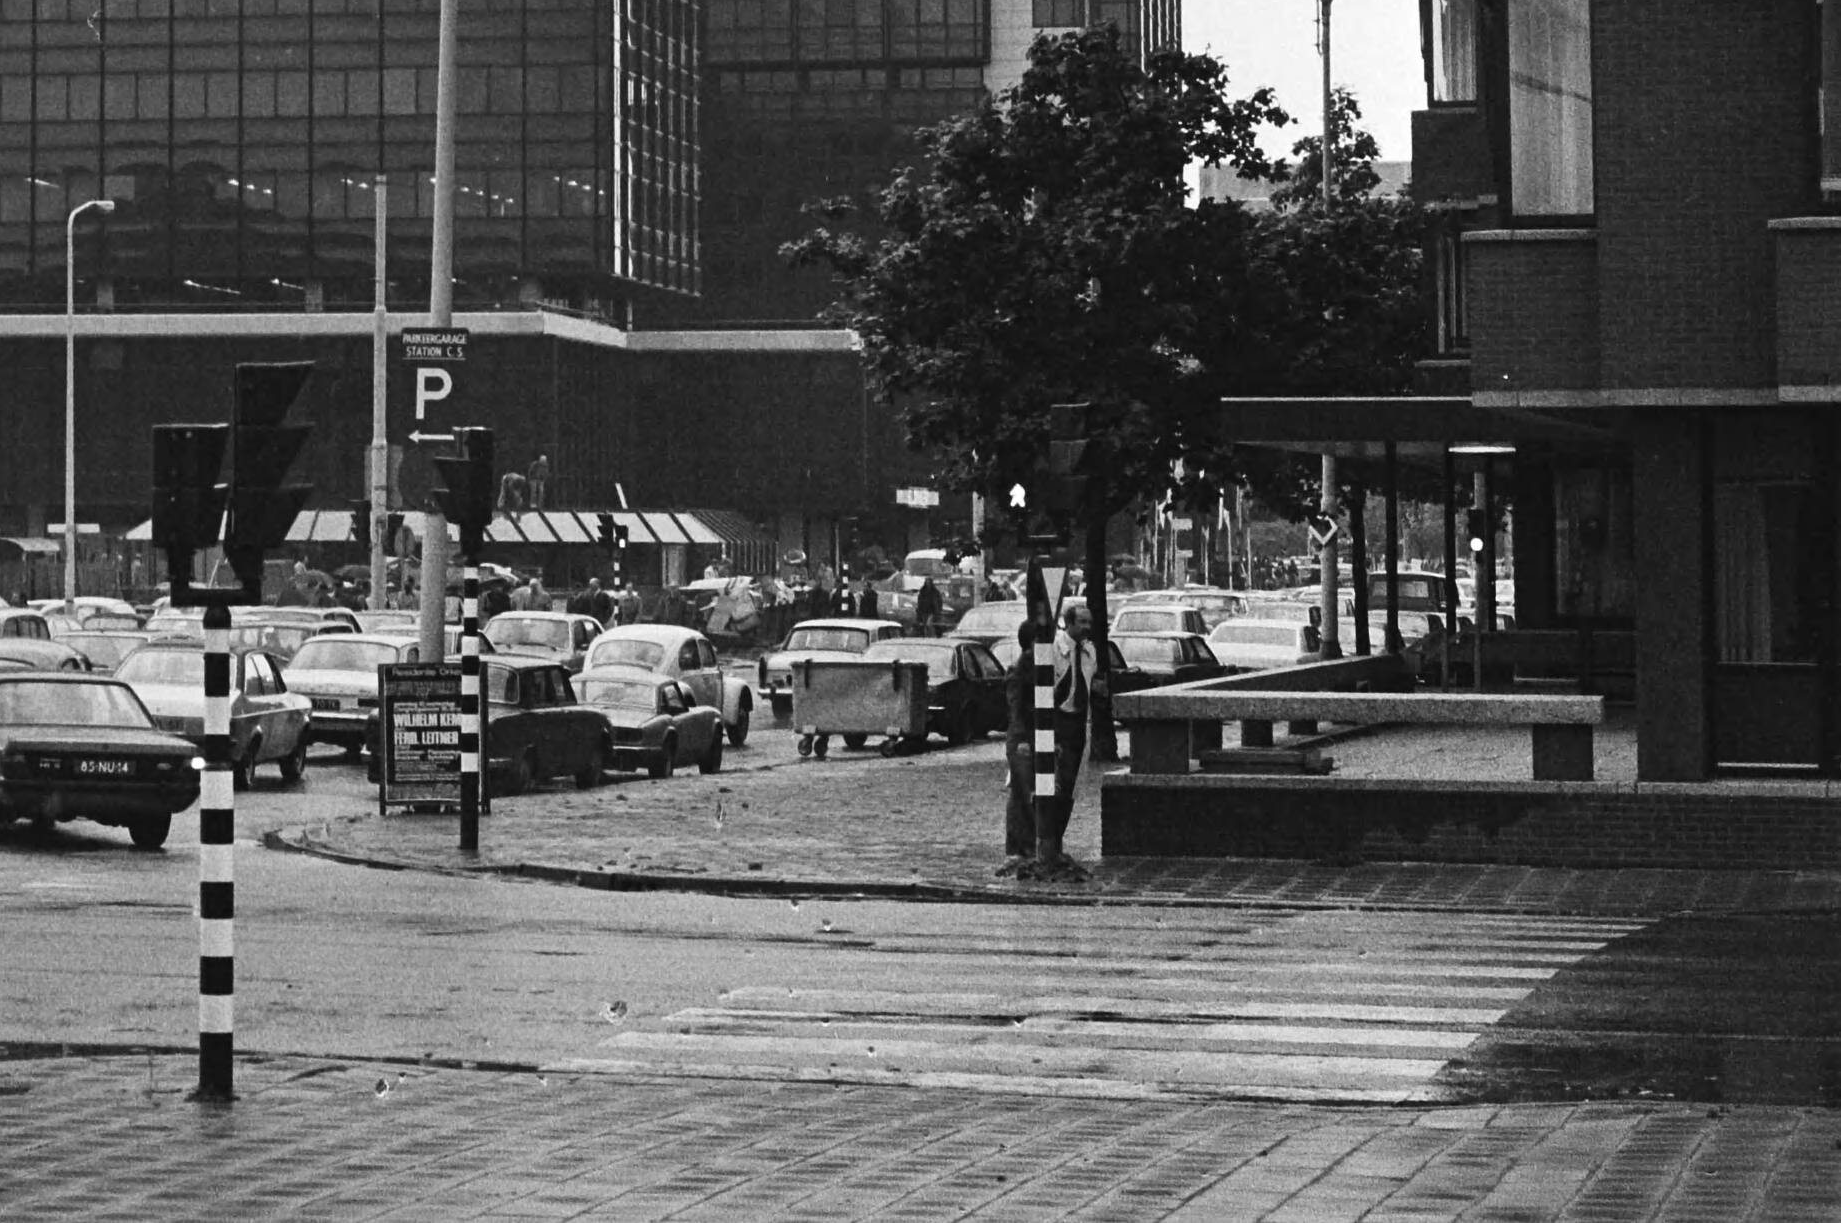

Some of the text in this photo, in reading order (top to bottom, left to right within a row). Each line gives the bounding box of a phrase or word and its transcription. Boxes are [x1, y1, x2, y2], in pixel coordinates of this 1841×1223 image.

[402, 333, 467, 345] PARKEERGARAGE
[406, 346, 442, 357] STATION
[416, 367, 453, 420] P
